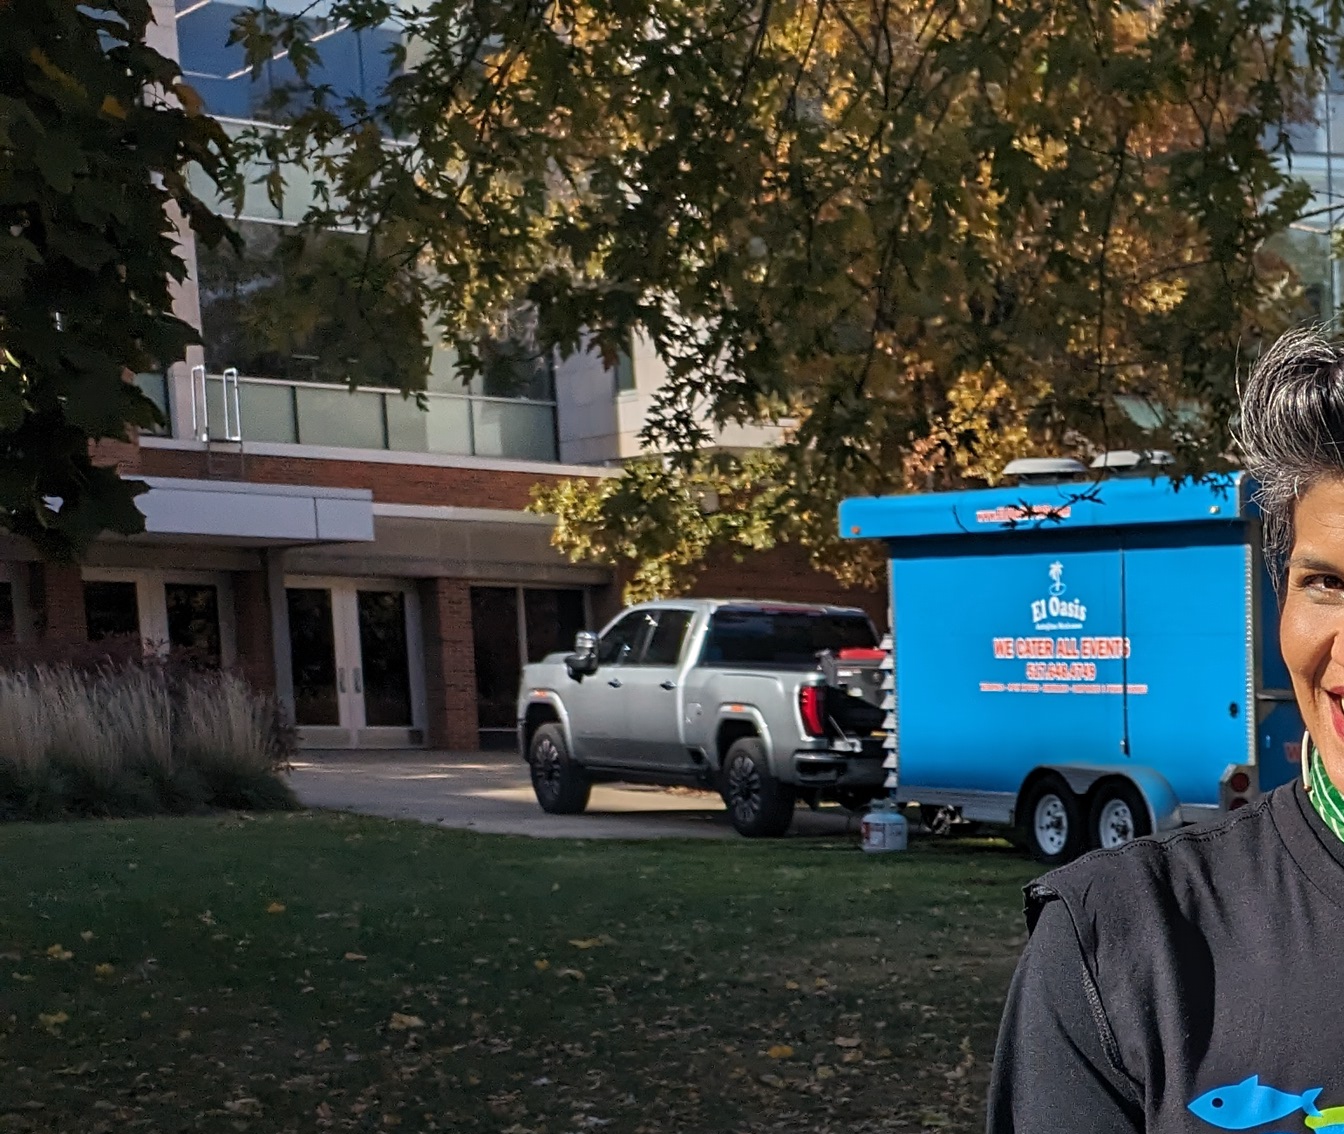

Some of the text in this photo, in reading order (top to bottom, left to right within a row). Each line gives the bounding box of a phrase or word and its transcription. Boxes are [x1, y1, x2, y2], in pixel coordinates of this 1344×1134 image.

[1031, 596, 1087, 623] El Oasis
[993, 637, 1130, 659] WE CATER ALL EVENTS
